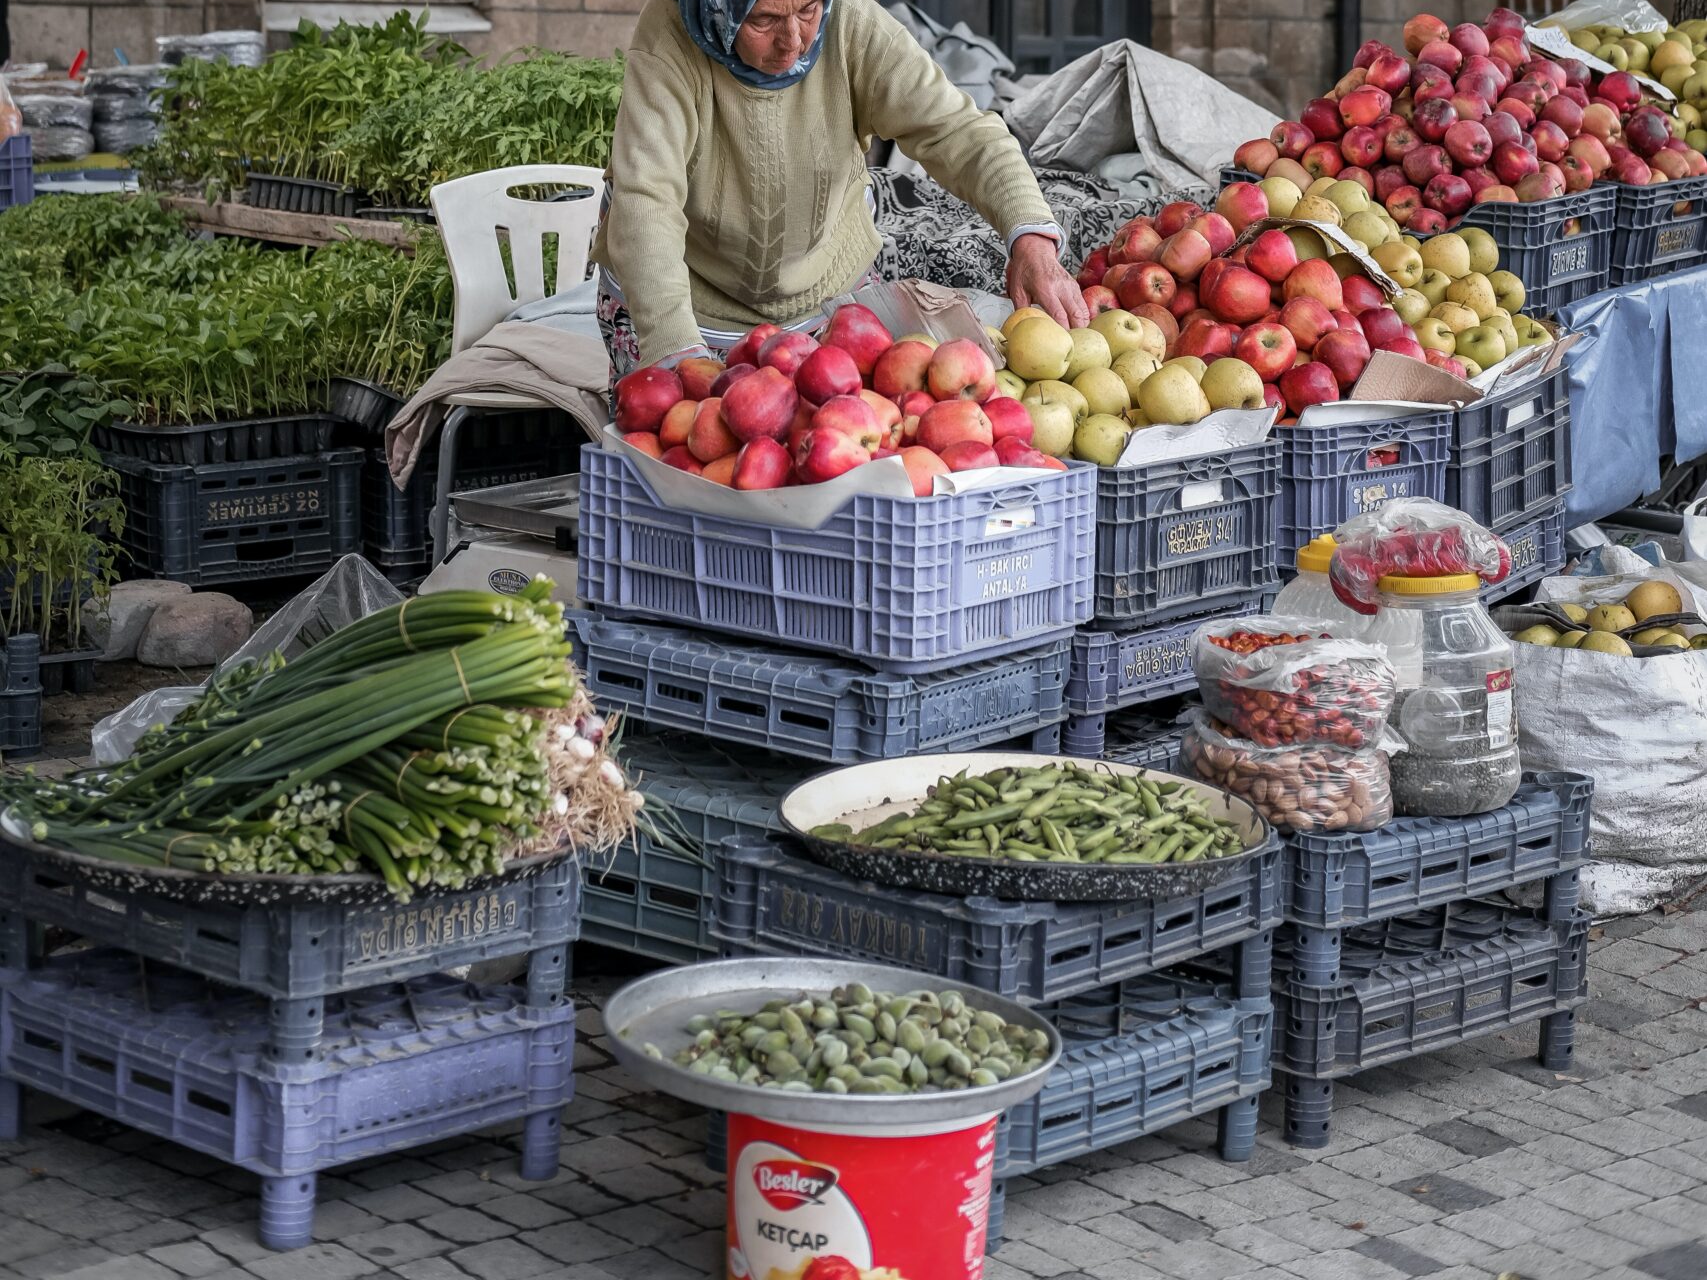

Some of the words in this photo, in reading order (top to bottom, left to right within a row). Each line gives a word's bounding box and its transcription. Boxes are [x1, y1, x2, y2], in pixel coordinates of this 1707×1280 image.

[1392, 482, 1407, 497] 14
[1167, 519, 1212, 543] GÜVEN
[982, 576, 1027, 598] ANTALYA
[424, 900, 517, 946] BESLEN
[360, 923, 418, 958] GIDA
[760, 1166, 824, 1194] Besler
[757, 1219, 829, 1252] KETÇAP
